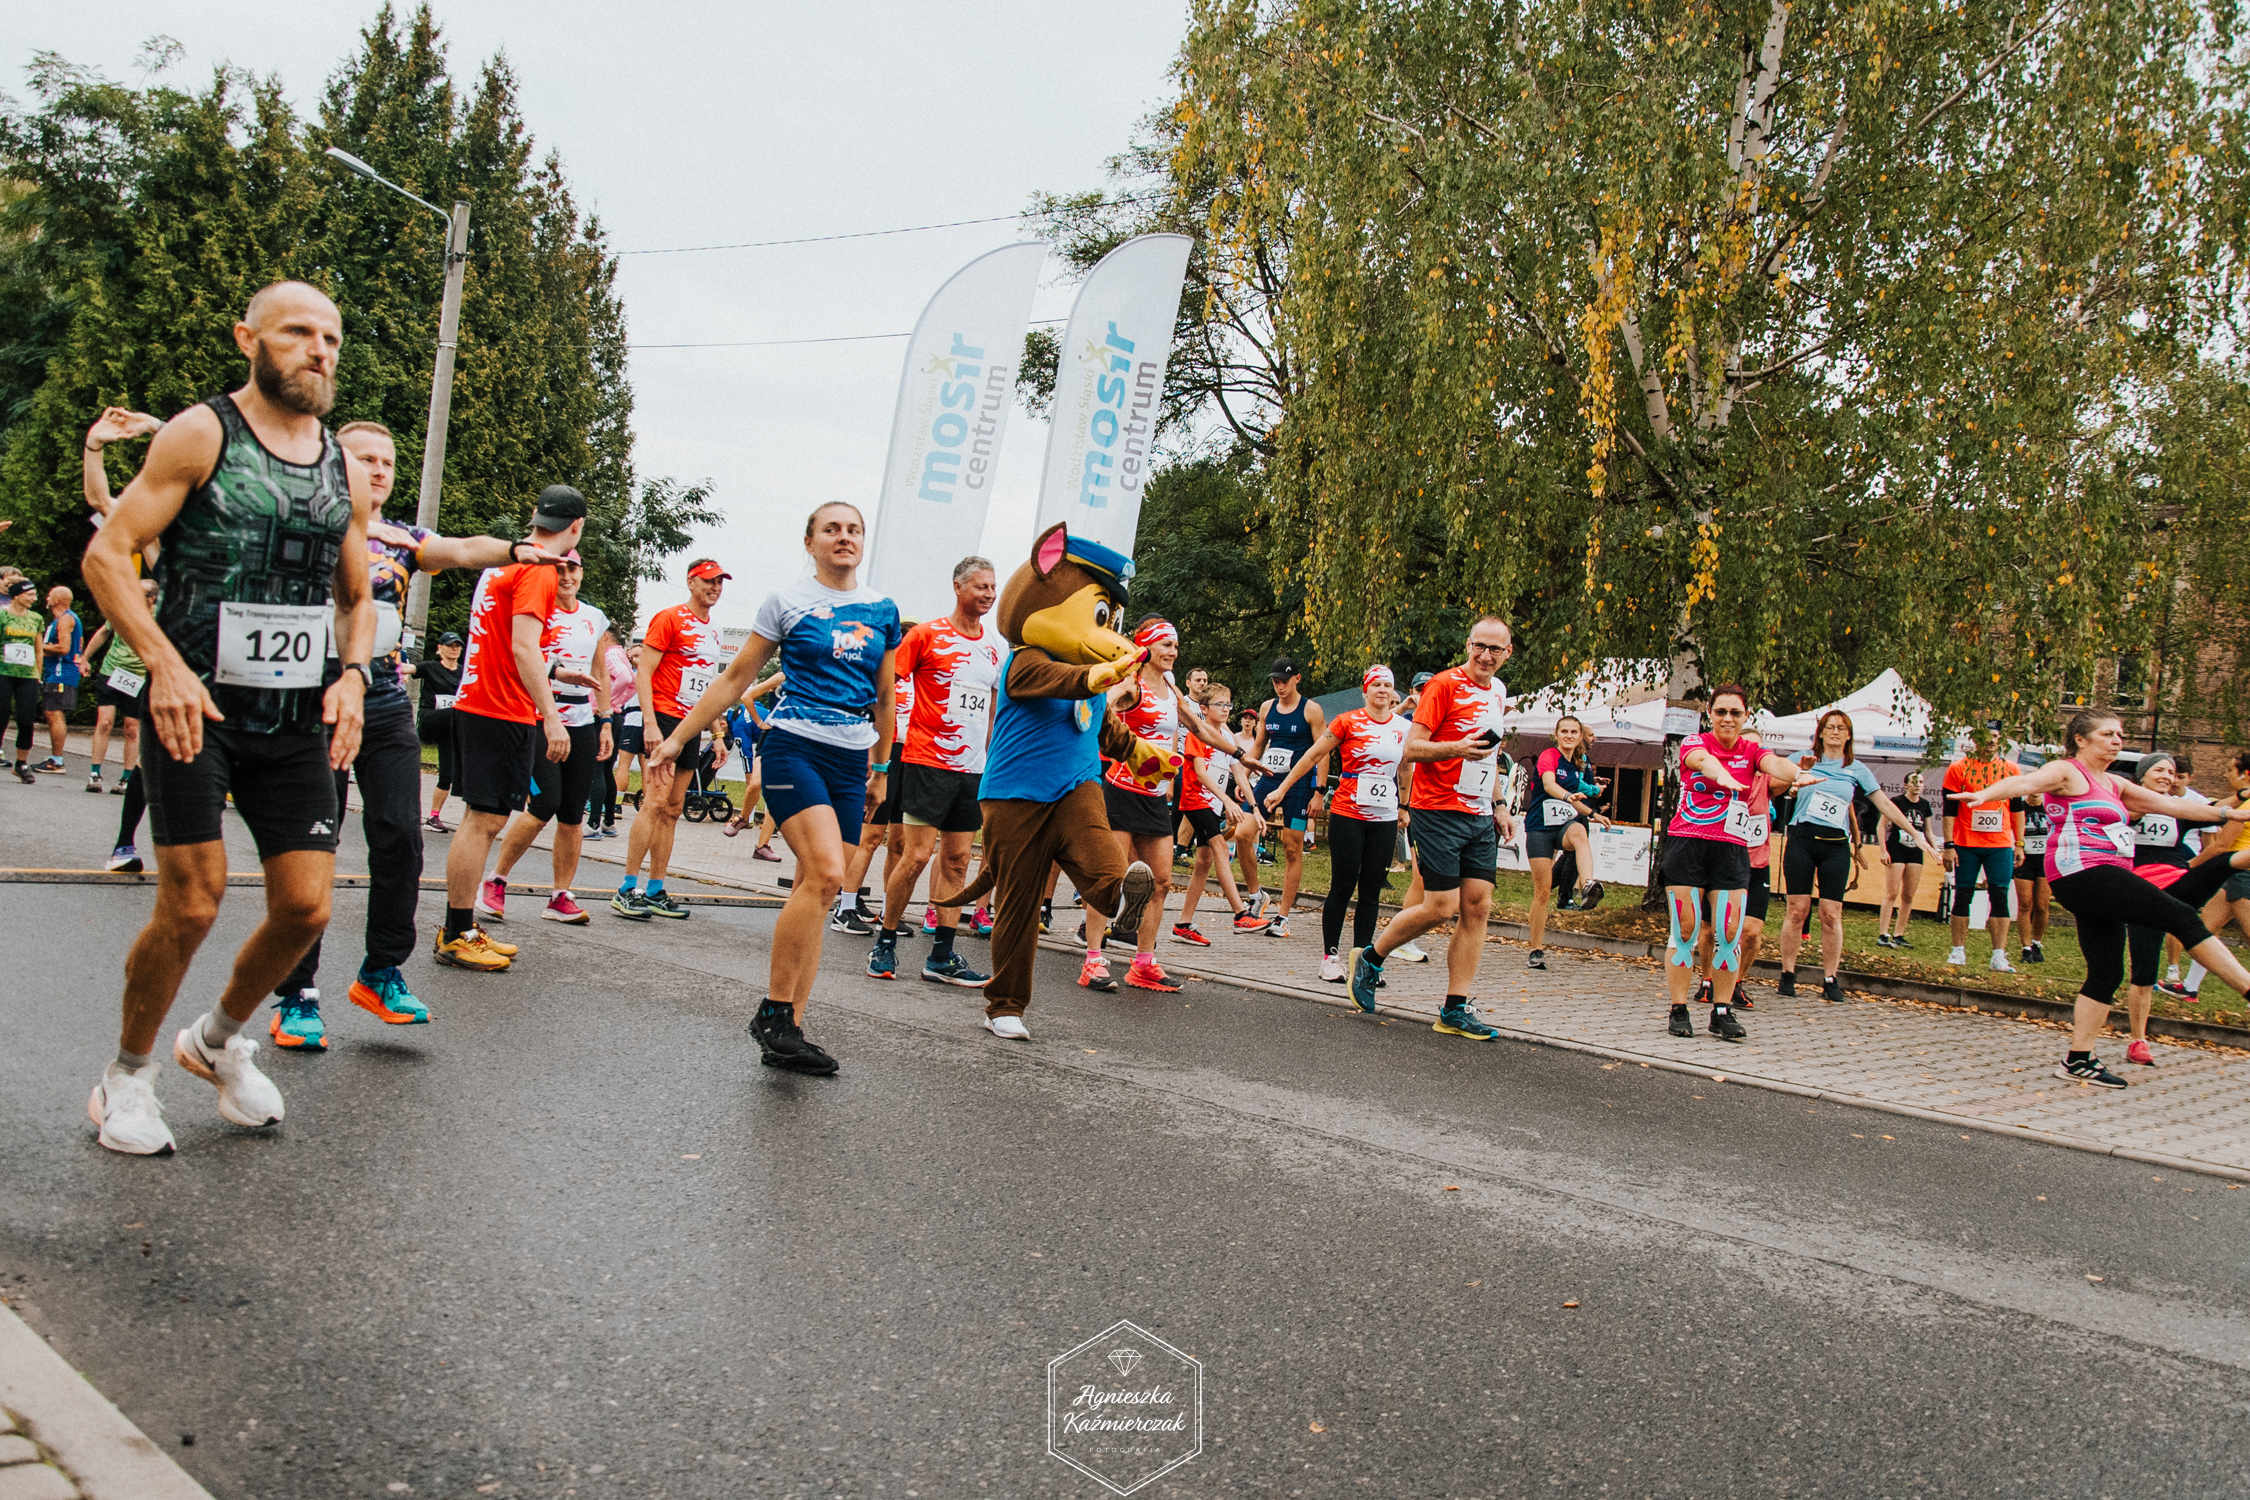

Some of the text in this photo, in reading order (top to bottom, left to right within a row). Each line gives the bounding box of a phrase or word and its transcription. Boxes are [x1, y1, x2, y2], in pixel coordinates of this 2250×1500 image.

[918, 333, 985, 504] mosir
[1079, 320, 1135, 508] mosir
[905, 378, 939, 488] Wodzisław Śląski
[966, 365, 1008, 489] centrum
[1066, 368, 1095, 490] Wodzisław Śląski
[1120, 361, 1157, 491] centrum
[246, 630, 311, 662] 120
[15, 649, 27, 658] 71
[117, 675, 136, 689] 164
[959, 693, 985, 712] 134
[1267, 755, 1285, 766] 182
[1218, 774, 1225, 785] 8
[1480, 770, 1488, 785] 7
[1370, 784, 1387, 797] 62
[1551, 806, 1573, 817] 148
[1820, 801, 1837, 814] 56
[1978, 817, 1998, 825] 200
[2137, 822, 2169, 836] 149
[2032, 841, 2044, 849] 25
